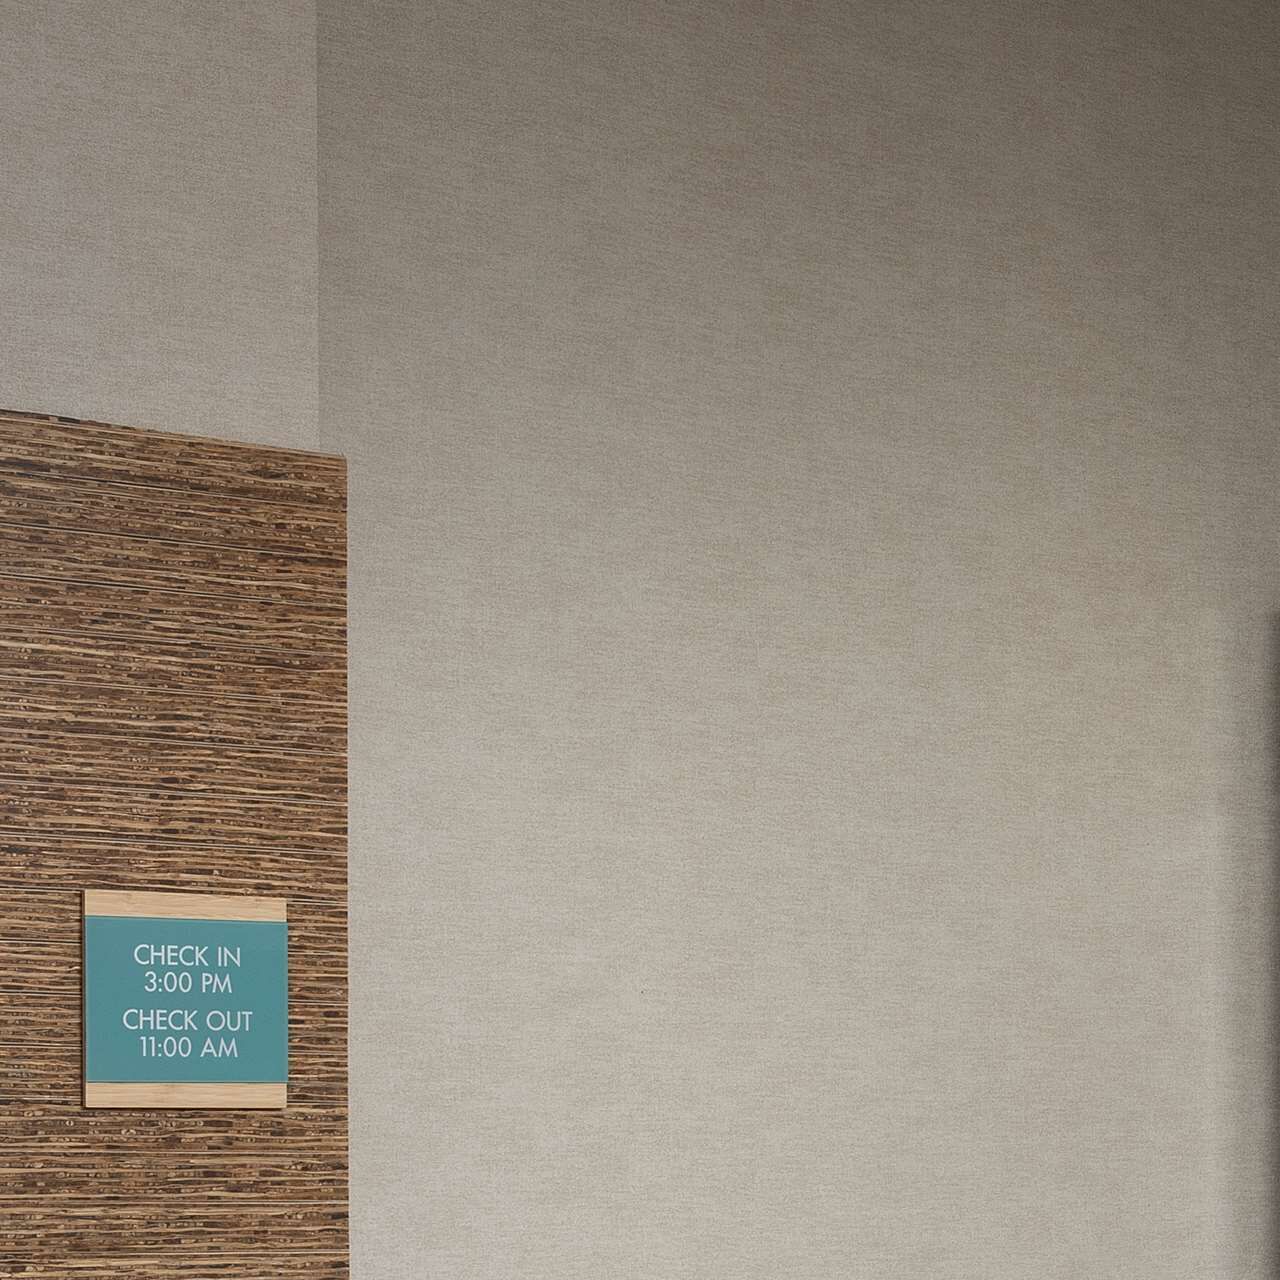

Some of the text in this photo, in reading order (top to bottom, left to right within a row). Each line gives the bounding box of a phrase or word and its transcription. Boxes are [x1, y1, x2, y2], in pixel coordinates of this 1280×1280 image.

[133, 945, 241, 967] CHECK IN
[144, 972, 232, 994] 3:00 PM
[122, 1009, 252, 1032] CHECK OUT
[138, 1036, 238, 1058] 11:00 AM
